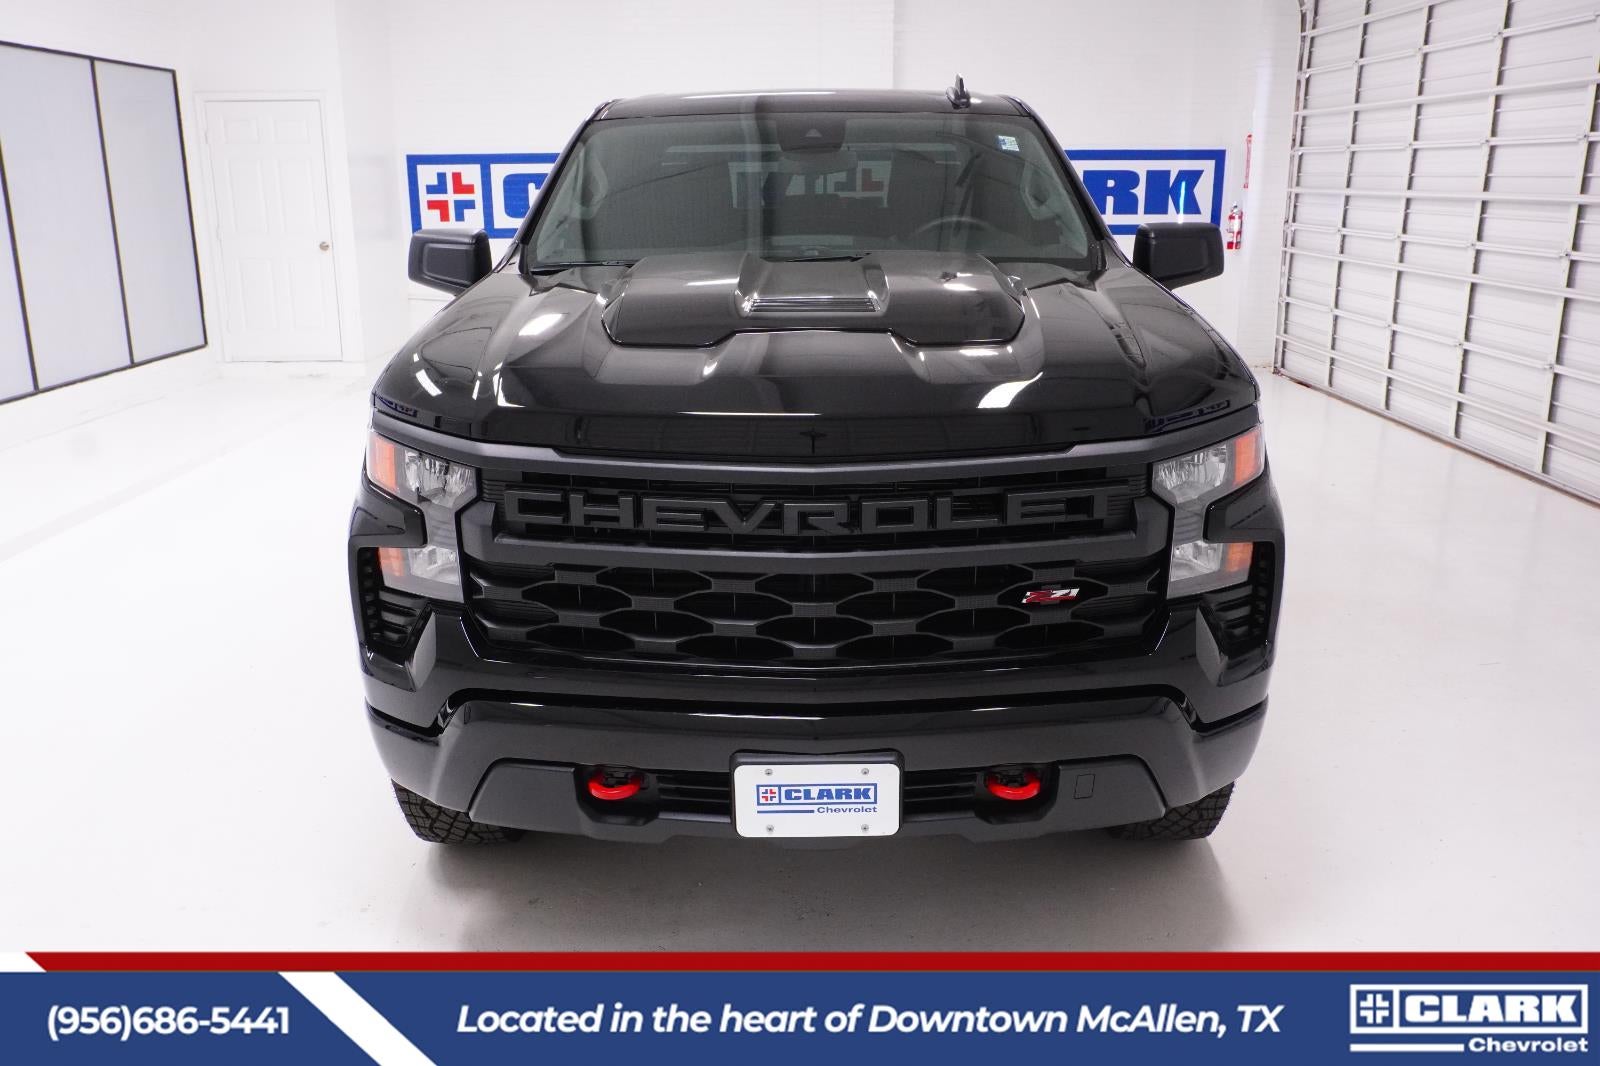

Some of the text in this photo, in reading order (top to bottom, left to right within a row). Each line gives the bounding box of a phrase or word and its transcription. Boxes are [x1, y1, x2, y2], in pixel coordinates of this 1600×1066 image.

[503, 485, 1129, 535] CHEVROLET
[784, 788, 872, 800] CLARK
[816, 806, 878, 814] Chevrolet
